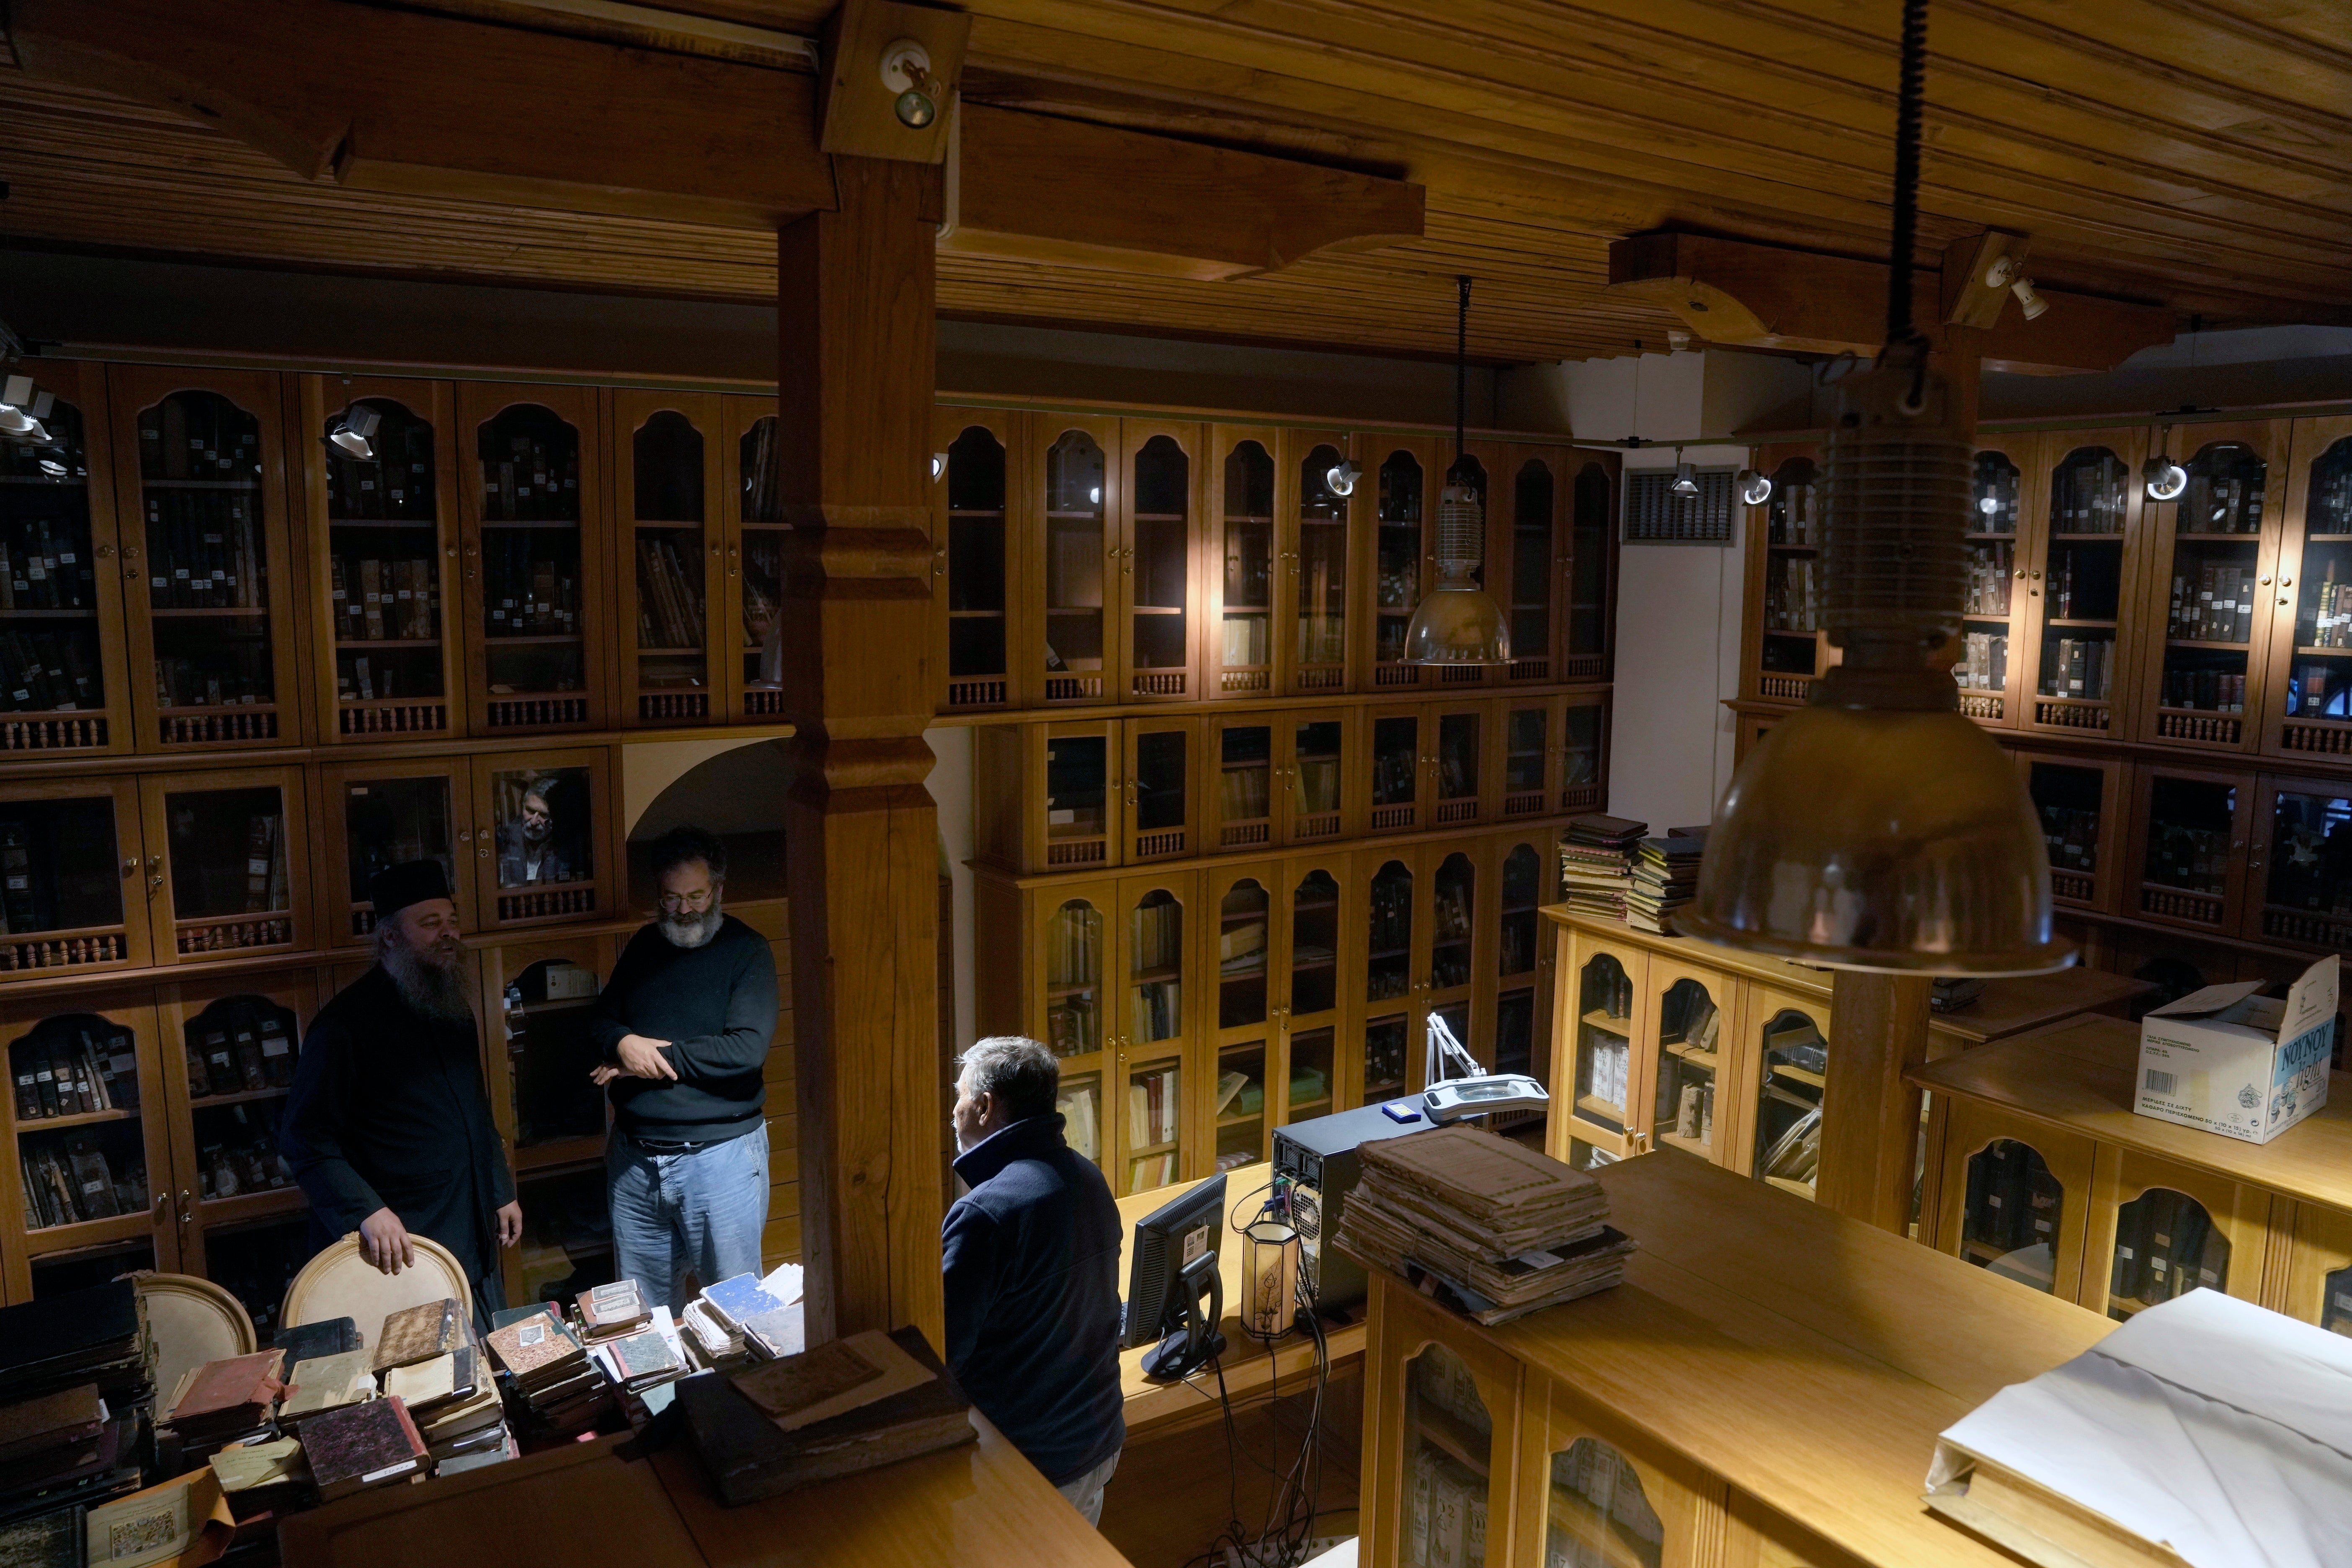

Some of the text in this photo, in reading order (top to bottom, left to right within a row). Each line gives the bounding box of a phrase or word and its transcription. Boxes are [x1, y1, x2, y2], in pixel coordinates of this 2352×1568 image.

[2296, 1052, 2322, 1091] light
[2142, 1096, 2165, 1106] ΜΕΡΙΔΕΣ
[2142, 1103, 2164, 1112] ΚΑΘΑΡΟ
[2165, 1109, 2204, 1122] ΠΕΡΙΕΧΟΜΕΝΟ
